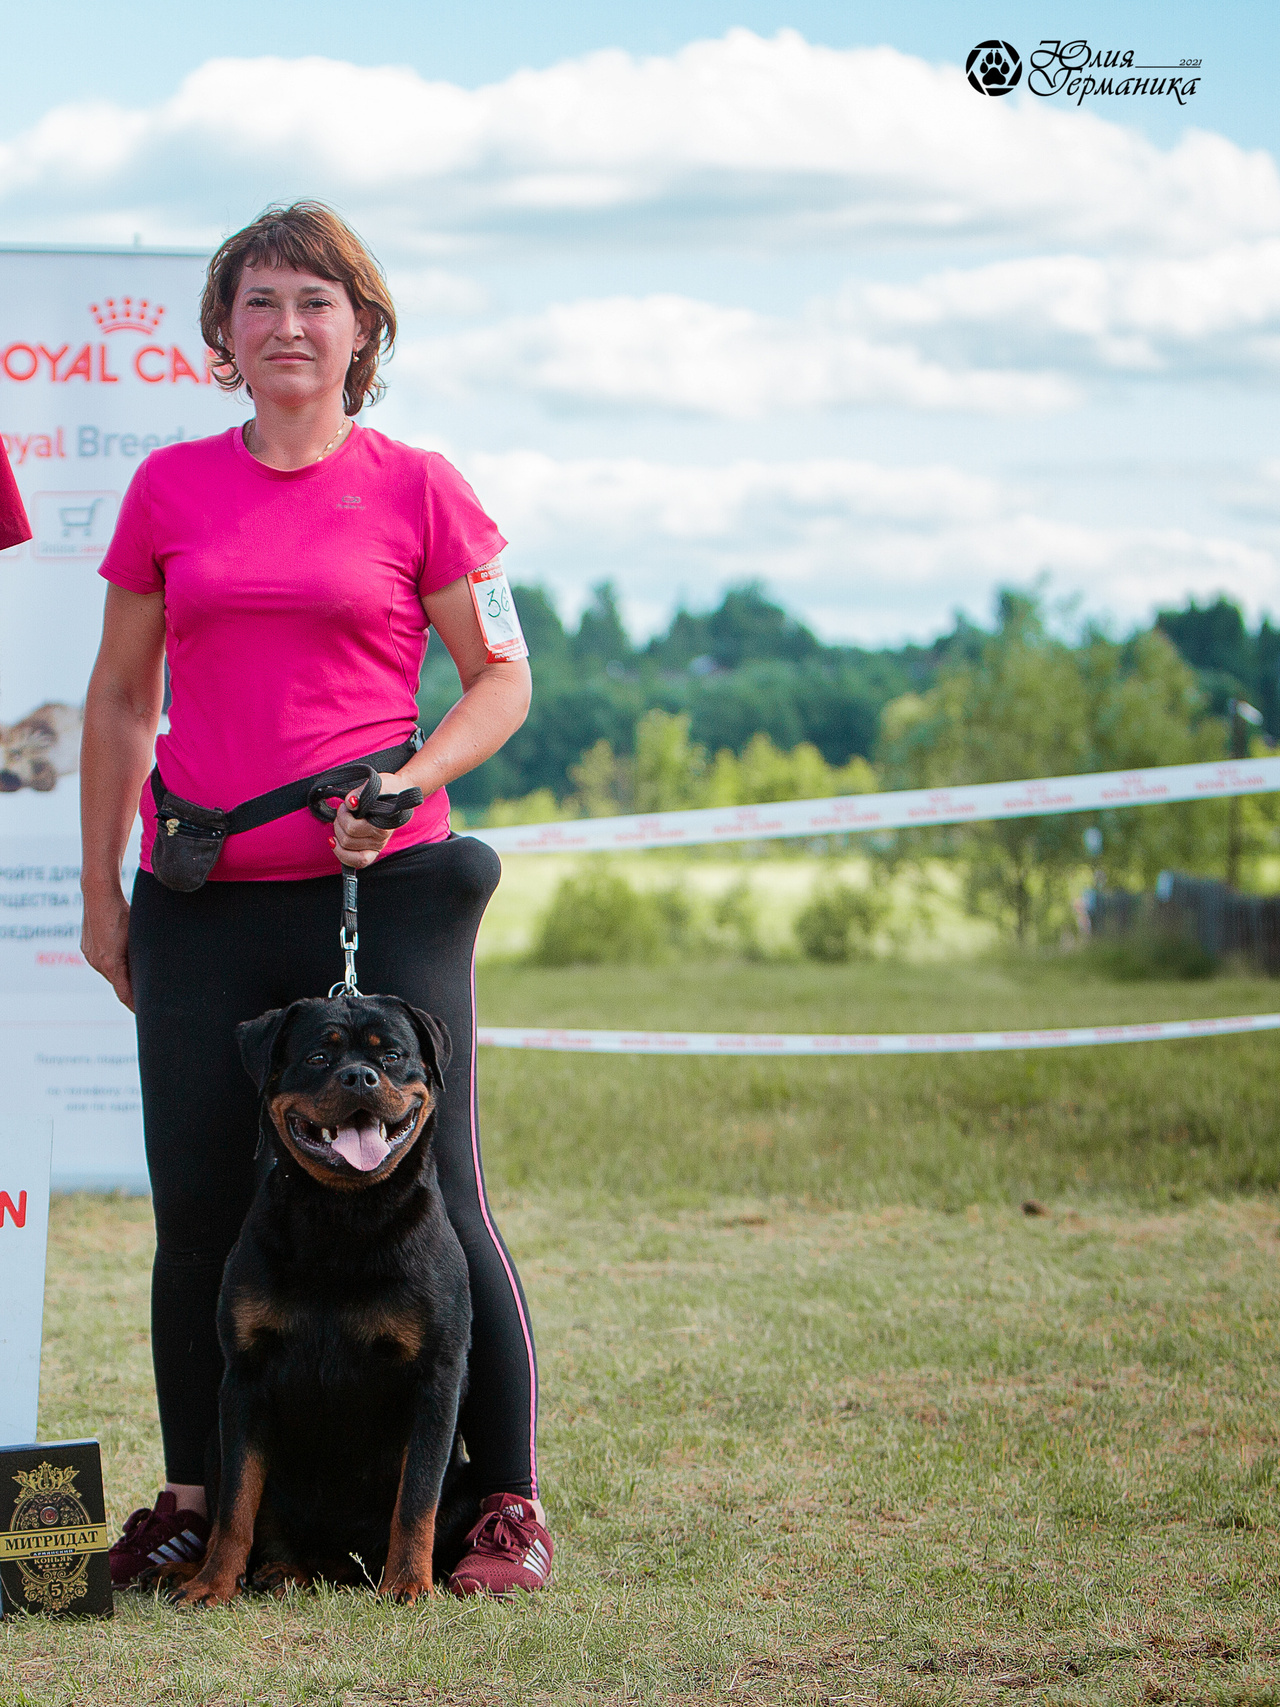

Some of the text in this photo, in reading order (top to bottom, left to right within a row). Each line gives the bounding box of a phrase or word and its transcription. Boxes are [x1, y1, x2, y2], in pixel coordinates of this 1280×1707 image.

[4, 1530, 98, 1551] МИТРИДАТ
[34, 1555, 73, 1565] КОНЬЯК
[51, 1583, 62, 1597] 5
